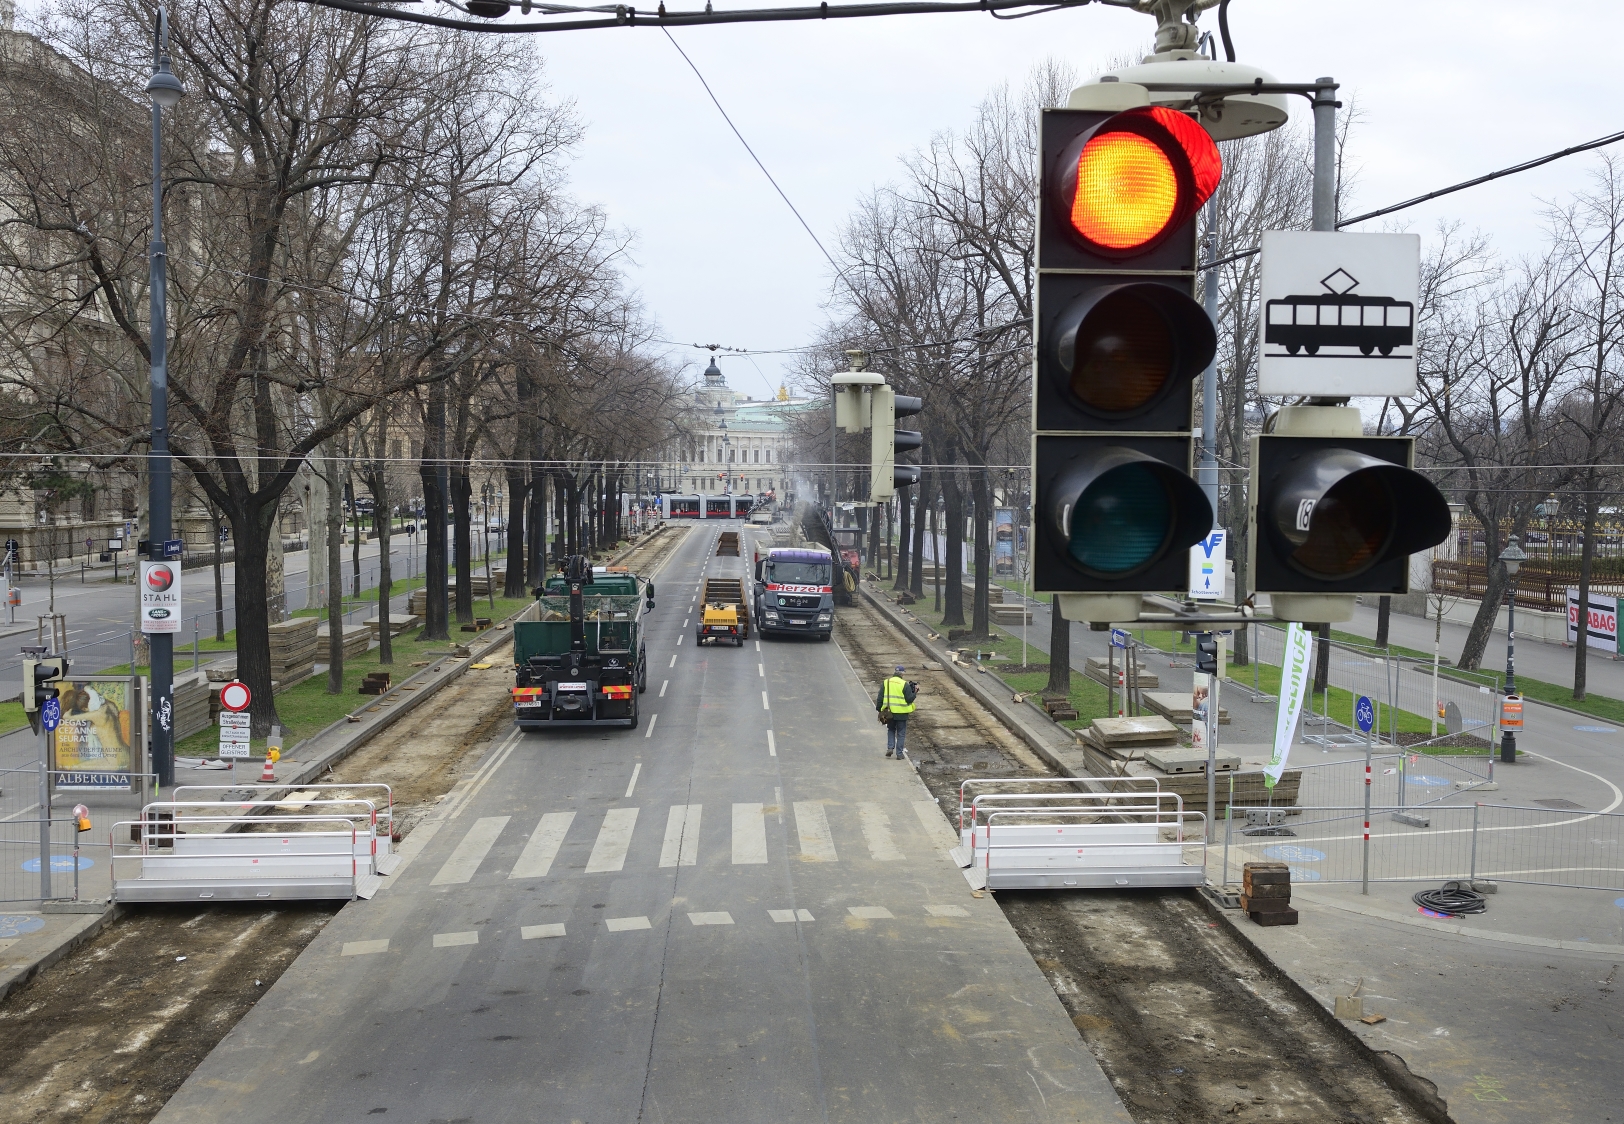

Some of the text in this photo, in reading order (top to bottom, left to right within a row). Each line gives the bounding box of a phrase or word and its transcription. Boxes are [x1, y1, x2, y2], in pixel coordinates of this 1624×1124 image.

[1299, 500, 1313, 528] 18
[777, 584, 823, 592] Herzer
[1570, 606, 1615, 632] STABAG
[58, 774, 128, 783] ALBERTINA
